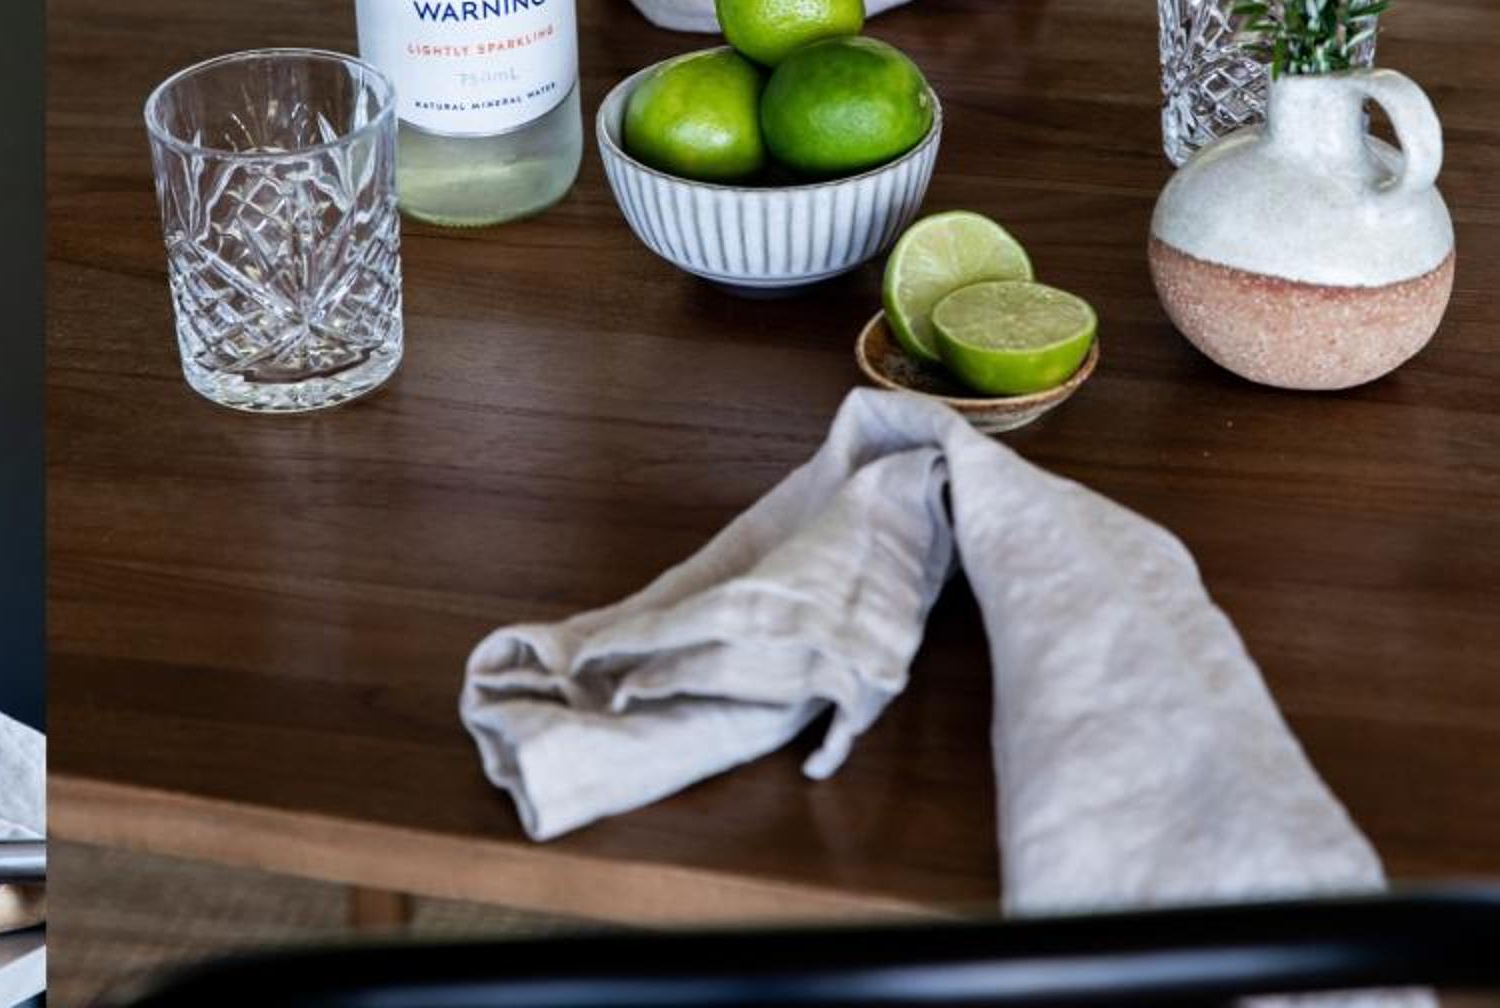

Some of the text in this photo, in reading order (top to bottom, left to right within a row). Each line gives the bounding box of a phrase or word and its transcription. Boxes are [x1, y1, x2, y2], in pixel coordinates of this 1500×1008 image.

[406, 23, 555, 57] LIGHTLY SPARKLING
[414, 101, 466, 111] NATURAL
[471, 95, 522, 111] MINERAL
